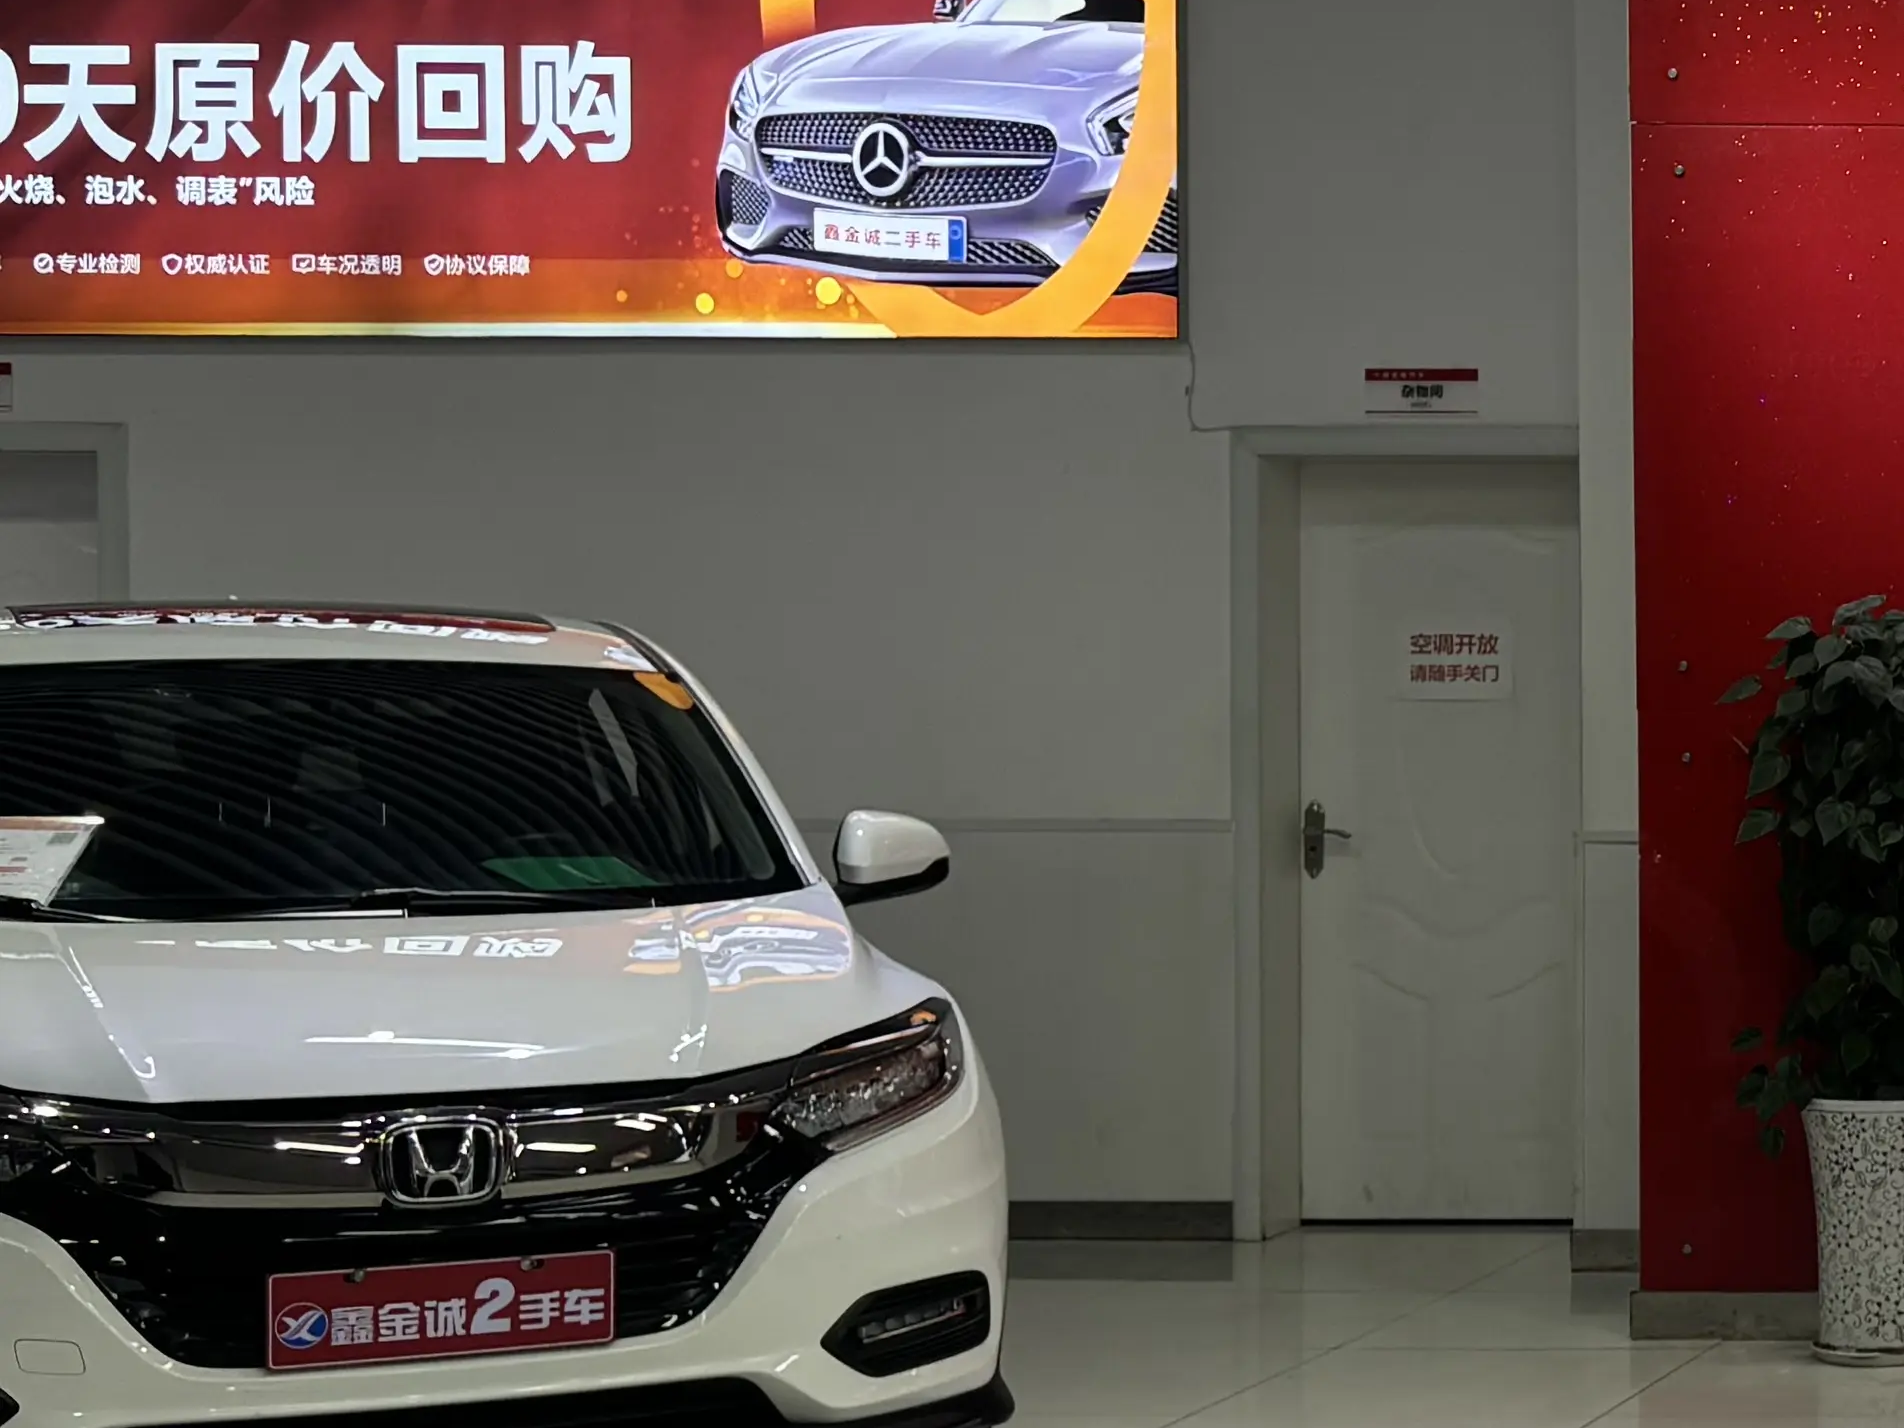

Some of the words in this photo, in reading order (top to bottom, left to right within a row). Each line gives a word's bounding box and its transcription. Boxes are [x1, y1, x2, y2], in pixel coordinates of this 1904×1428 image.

[0, 40, 632, 164] 天原价回购
[56, 253, 141, 276] 专业检测
[185, 253, 270, 276] 权威认证
[317, 253, 402, 276] 车况透明
[445, 253, 531, 276] 协议保障
[1410, 632, 1499, 655] 空调开放
[1410, 664, 1499, 683] 请随手关门
[330, 1277, 605, 1346] 鑫金诚2手车
